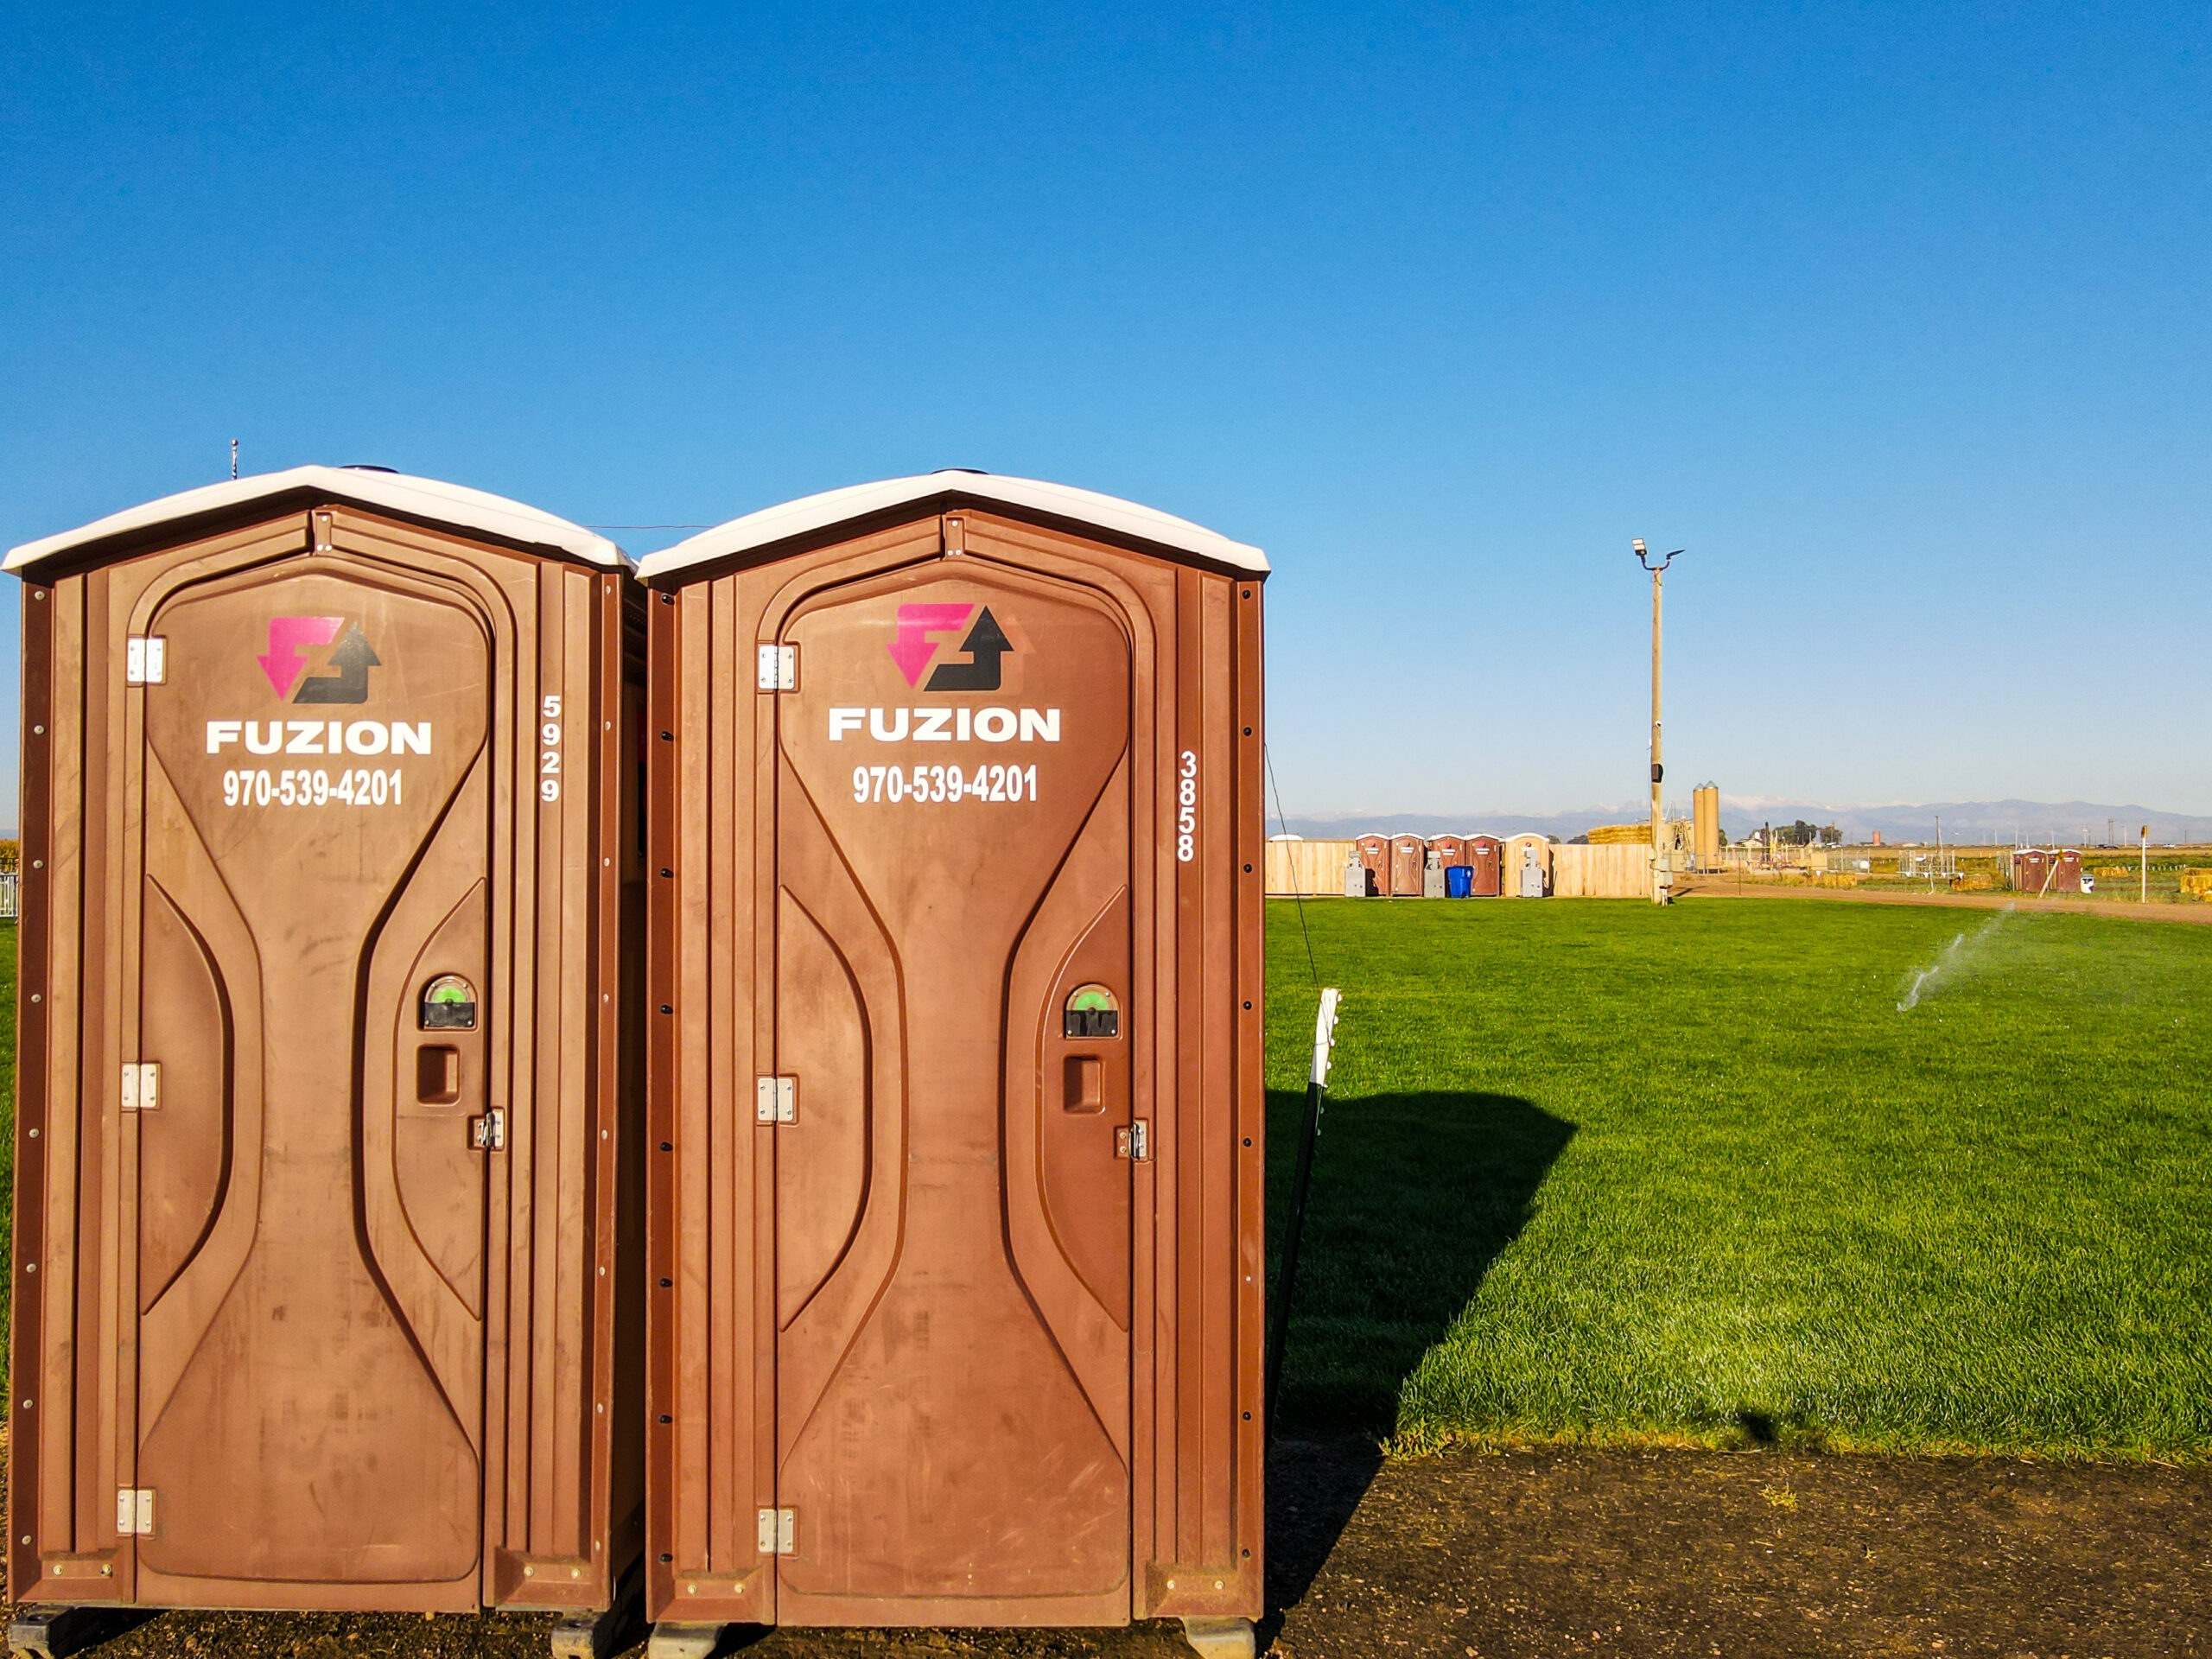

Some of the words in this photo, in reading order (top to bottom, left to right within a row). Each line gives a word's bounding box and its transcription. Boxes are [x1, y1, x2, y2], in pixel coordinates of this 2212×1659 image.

[207, 721, 431, 755] FUZION
[829, 707, 1060, 742] FUZION
[541, 695, 562, 803] 5929
[223, 769, 402, 806] 970-539-4201
[853, 765, 1037, 804] 970-539-4201
[1177, 750, 1198, 862] 3858
